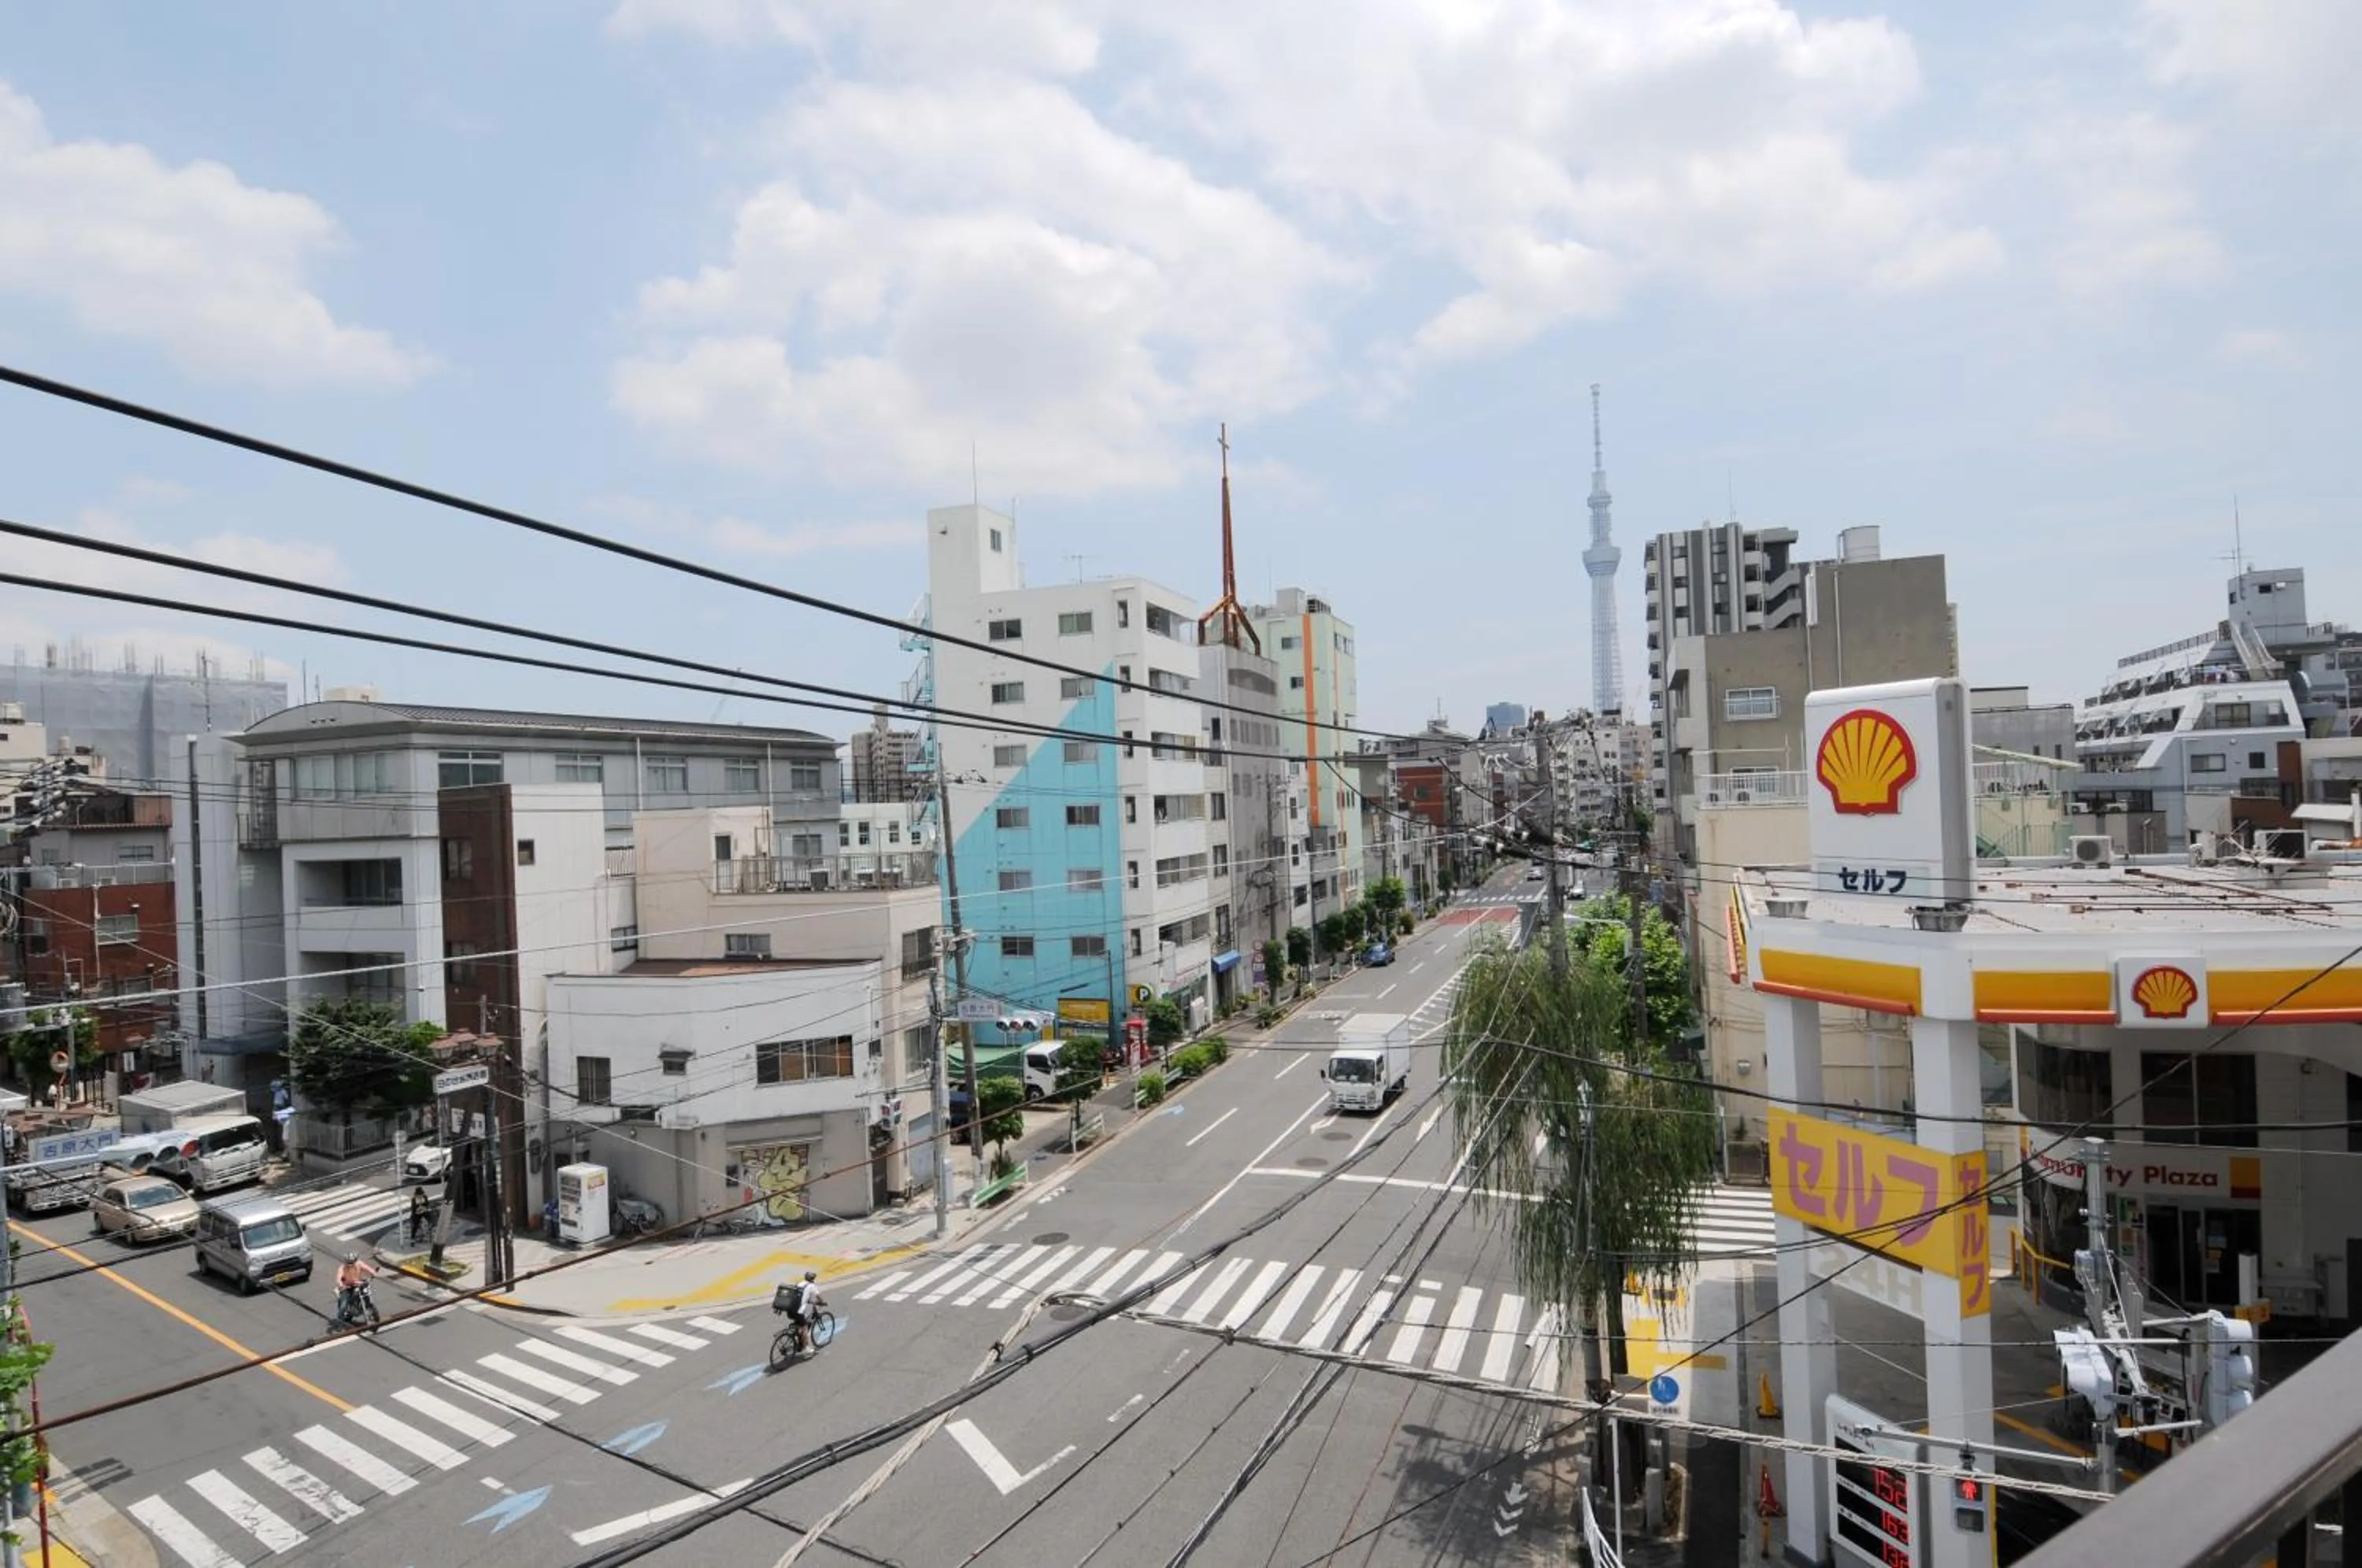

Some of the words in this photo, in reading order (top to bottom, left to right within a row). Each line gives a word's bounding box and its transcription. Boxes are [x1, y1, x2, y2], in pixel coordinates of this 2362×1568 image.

[1838, 866, 1907, 893] セルフ
[1138, 986, 1149, 1001] P
[1779, 1119, 1939, 1248] セルフ
[2143, 1164, 2218, 1187] Plaza
[1960, 1161, 1985, 1310] セルフ
[1874, 1466, 1911, 1514] 152
[1882, 1507, 1912, 1544] 163
